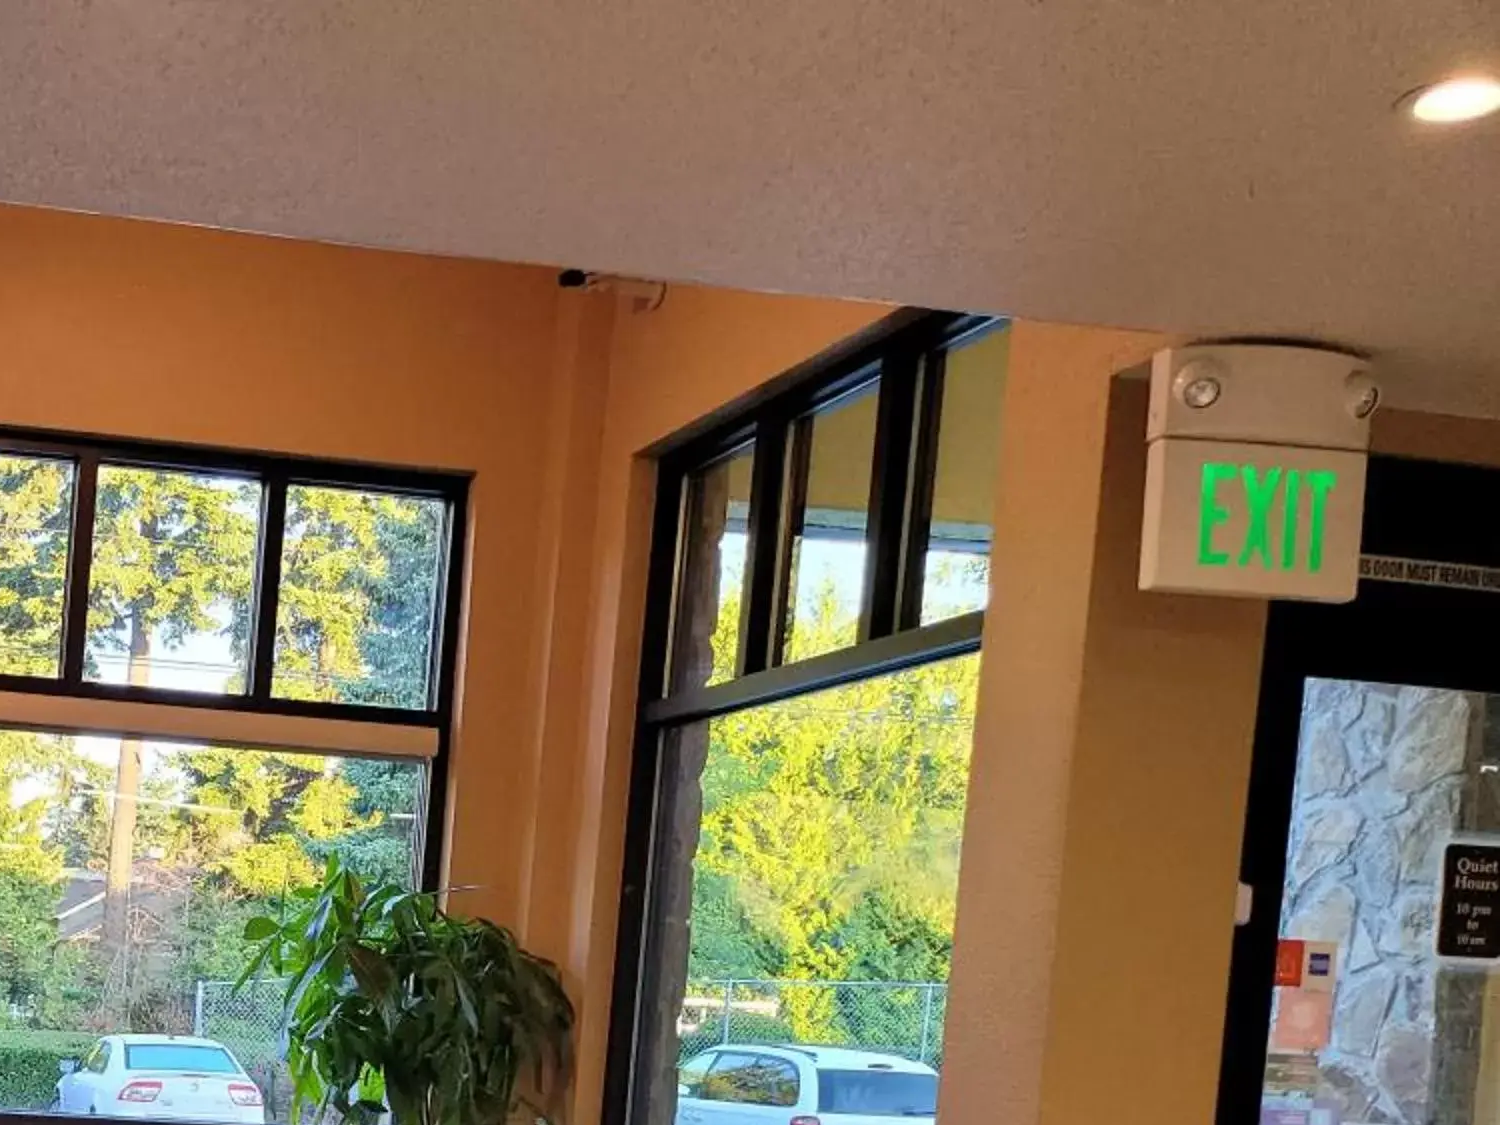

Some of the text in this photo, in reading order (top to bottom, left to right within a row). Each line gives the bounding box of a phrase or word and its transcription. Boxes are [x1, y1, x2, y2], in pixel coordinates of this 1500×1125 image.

[1198, 462, 1338, 574] EXIT
[1457, 857, 1499, 875] Quiet
[1454, 875, 1498, 891] Hours
